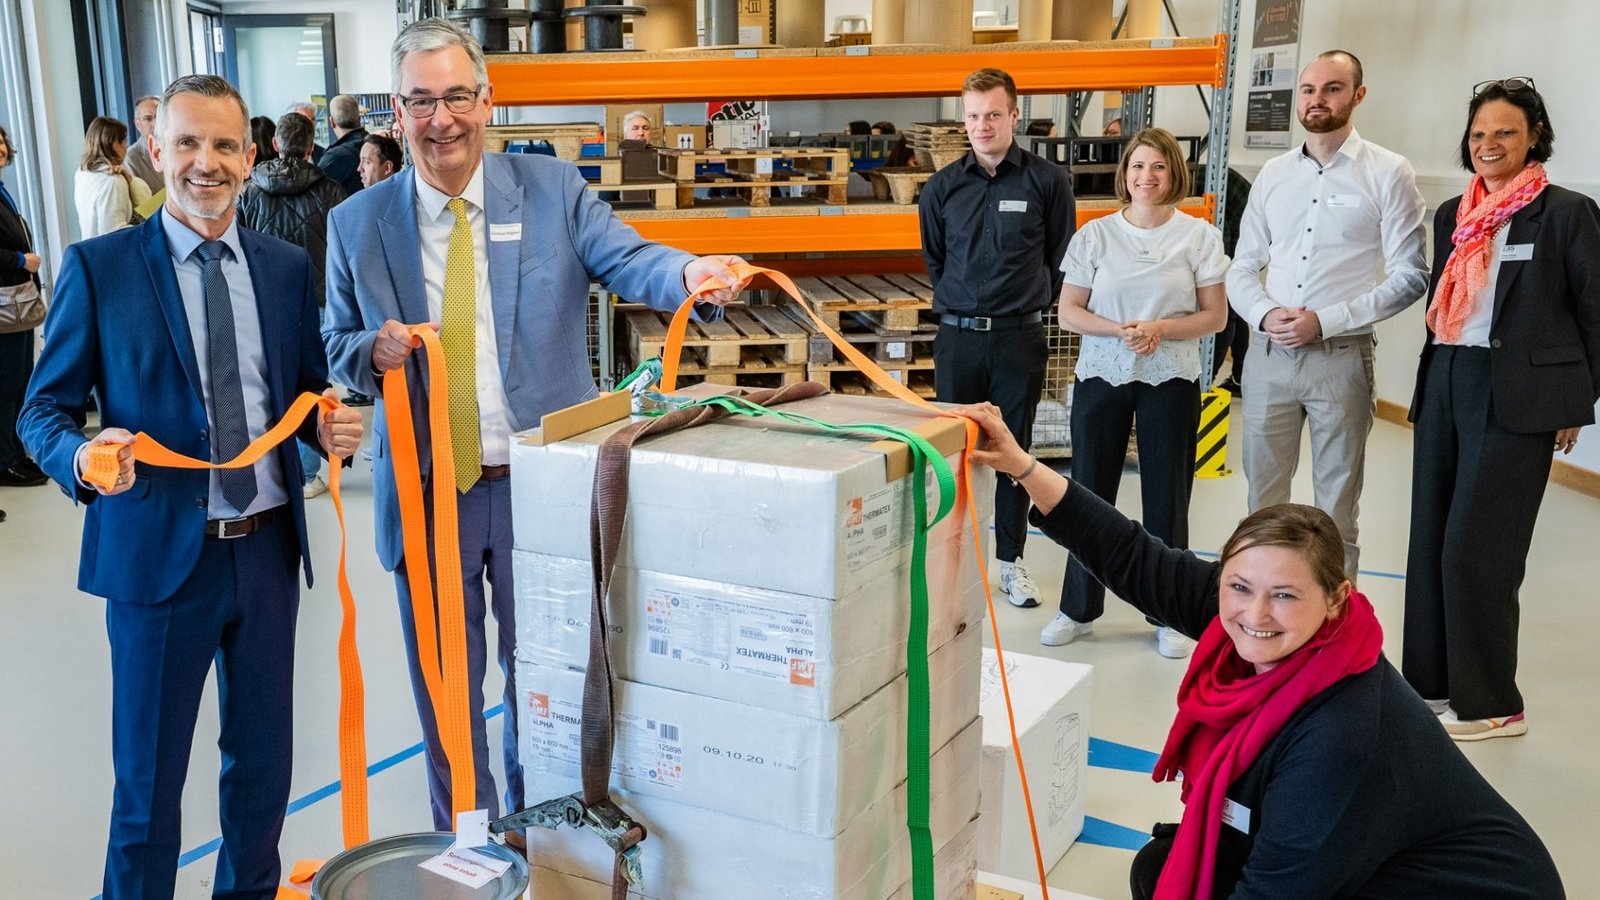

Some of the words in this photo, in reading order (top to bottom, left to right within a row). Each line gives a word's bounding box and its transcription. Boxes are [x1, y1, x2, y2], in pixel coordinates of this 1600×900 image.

[863, 505, 891, 520] THERMATEX
[847, 528, 864, 538] APHA
[767, 622, 781, 630] mm
[781, 625, 794, 634] 600
[801, 628, 814, 636] 600
[736, 646, 788, 664] THERMATEX
[786, 646, 814, 656] ALPHA
[791, 658, 814, 677] AMF
[551, 711, 582, 726] THERMA
[657, 743, 682, 755] 125898
[703, 745, 765, 765] 09.10.20
